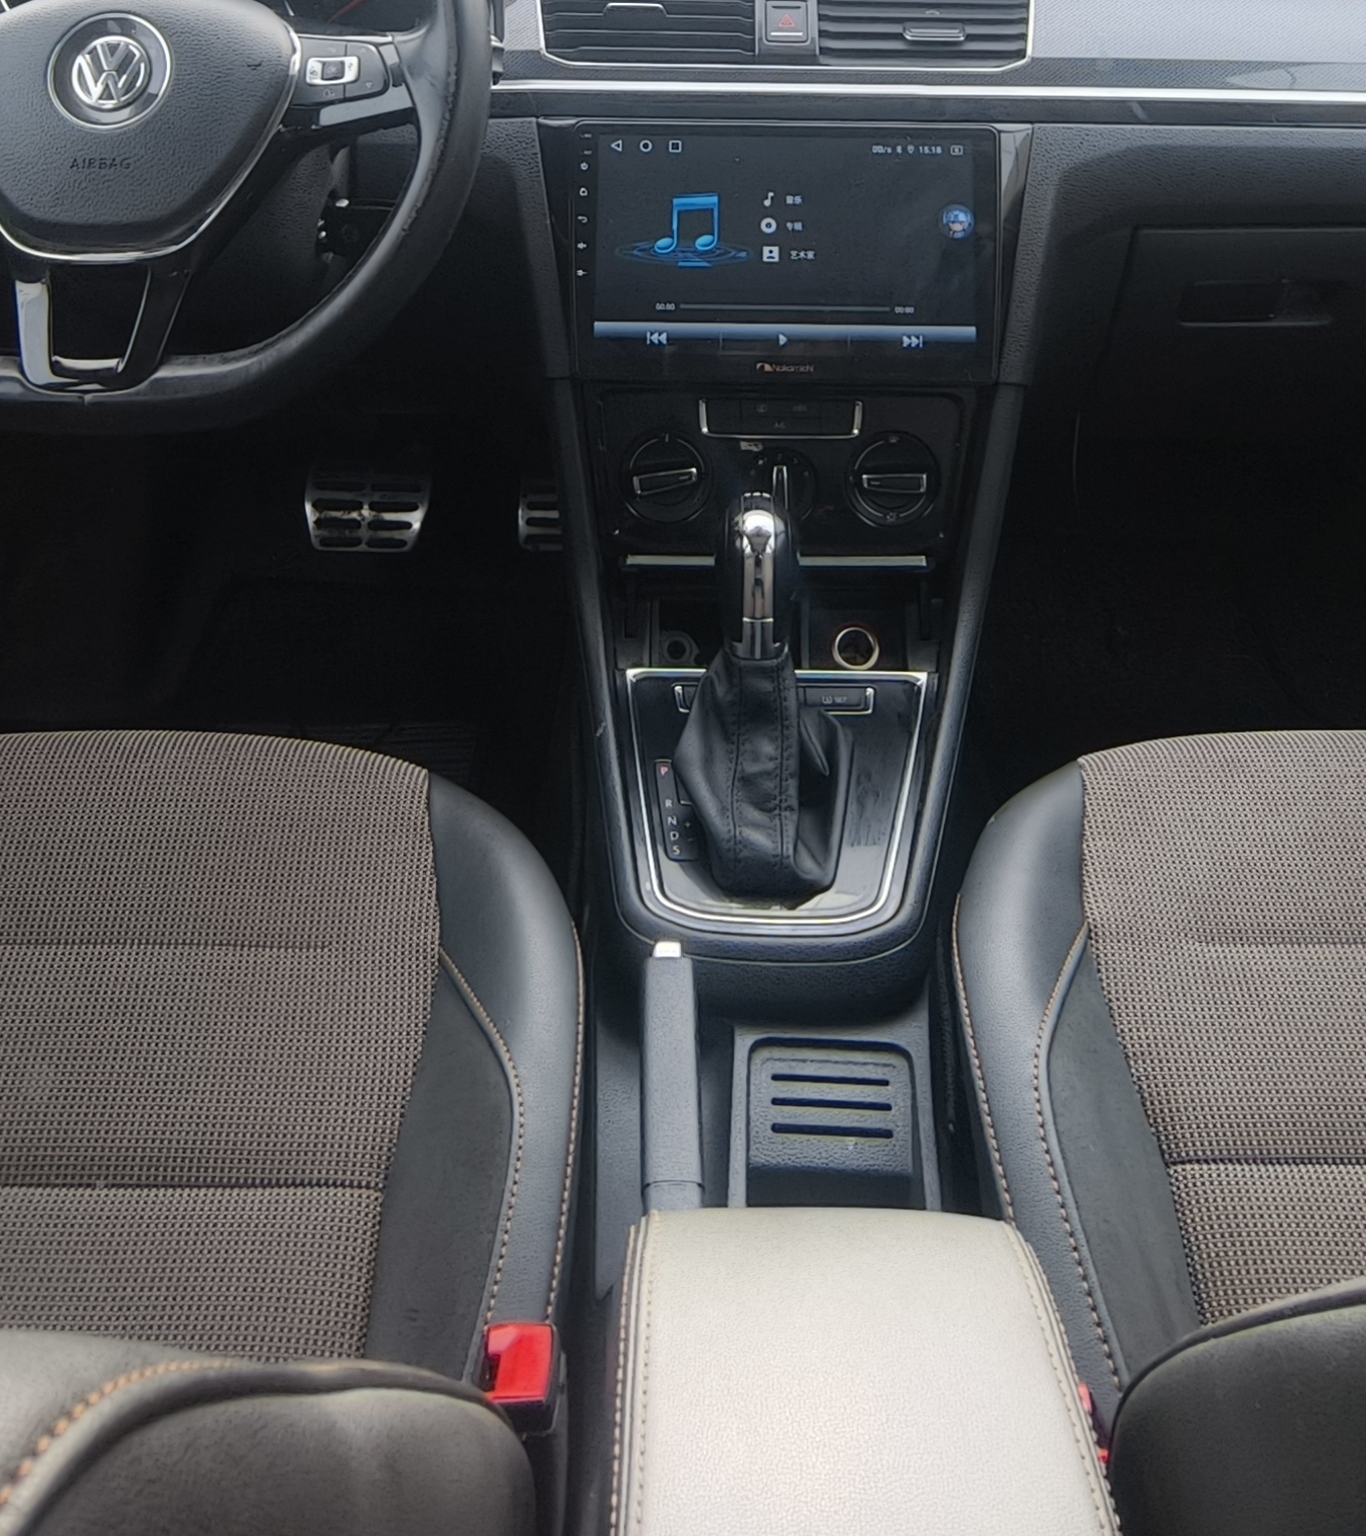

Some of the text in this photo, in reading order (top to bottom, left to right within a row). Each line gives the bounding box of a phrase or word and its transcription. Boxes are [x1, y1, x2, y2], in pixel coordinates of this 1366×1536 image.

[69, 156, 133, 170] AIRBAG
[660, 766, 669, 777] P
[664, 798, 673, 808] R
[667, 815, 678, 826] N
[669, 830, 680, 842] D
[671, 844, 681, 855] S
